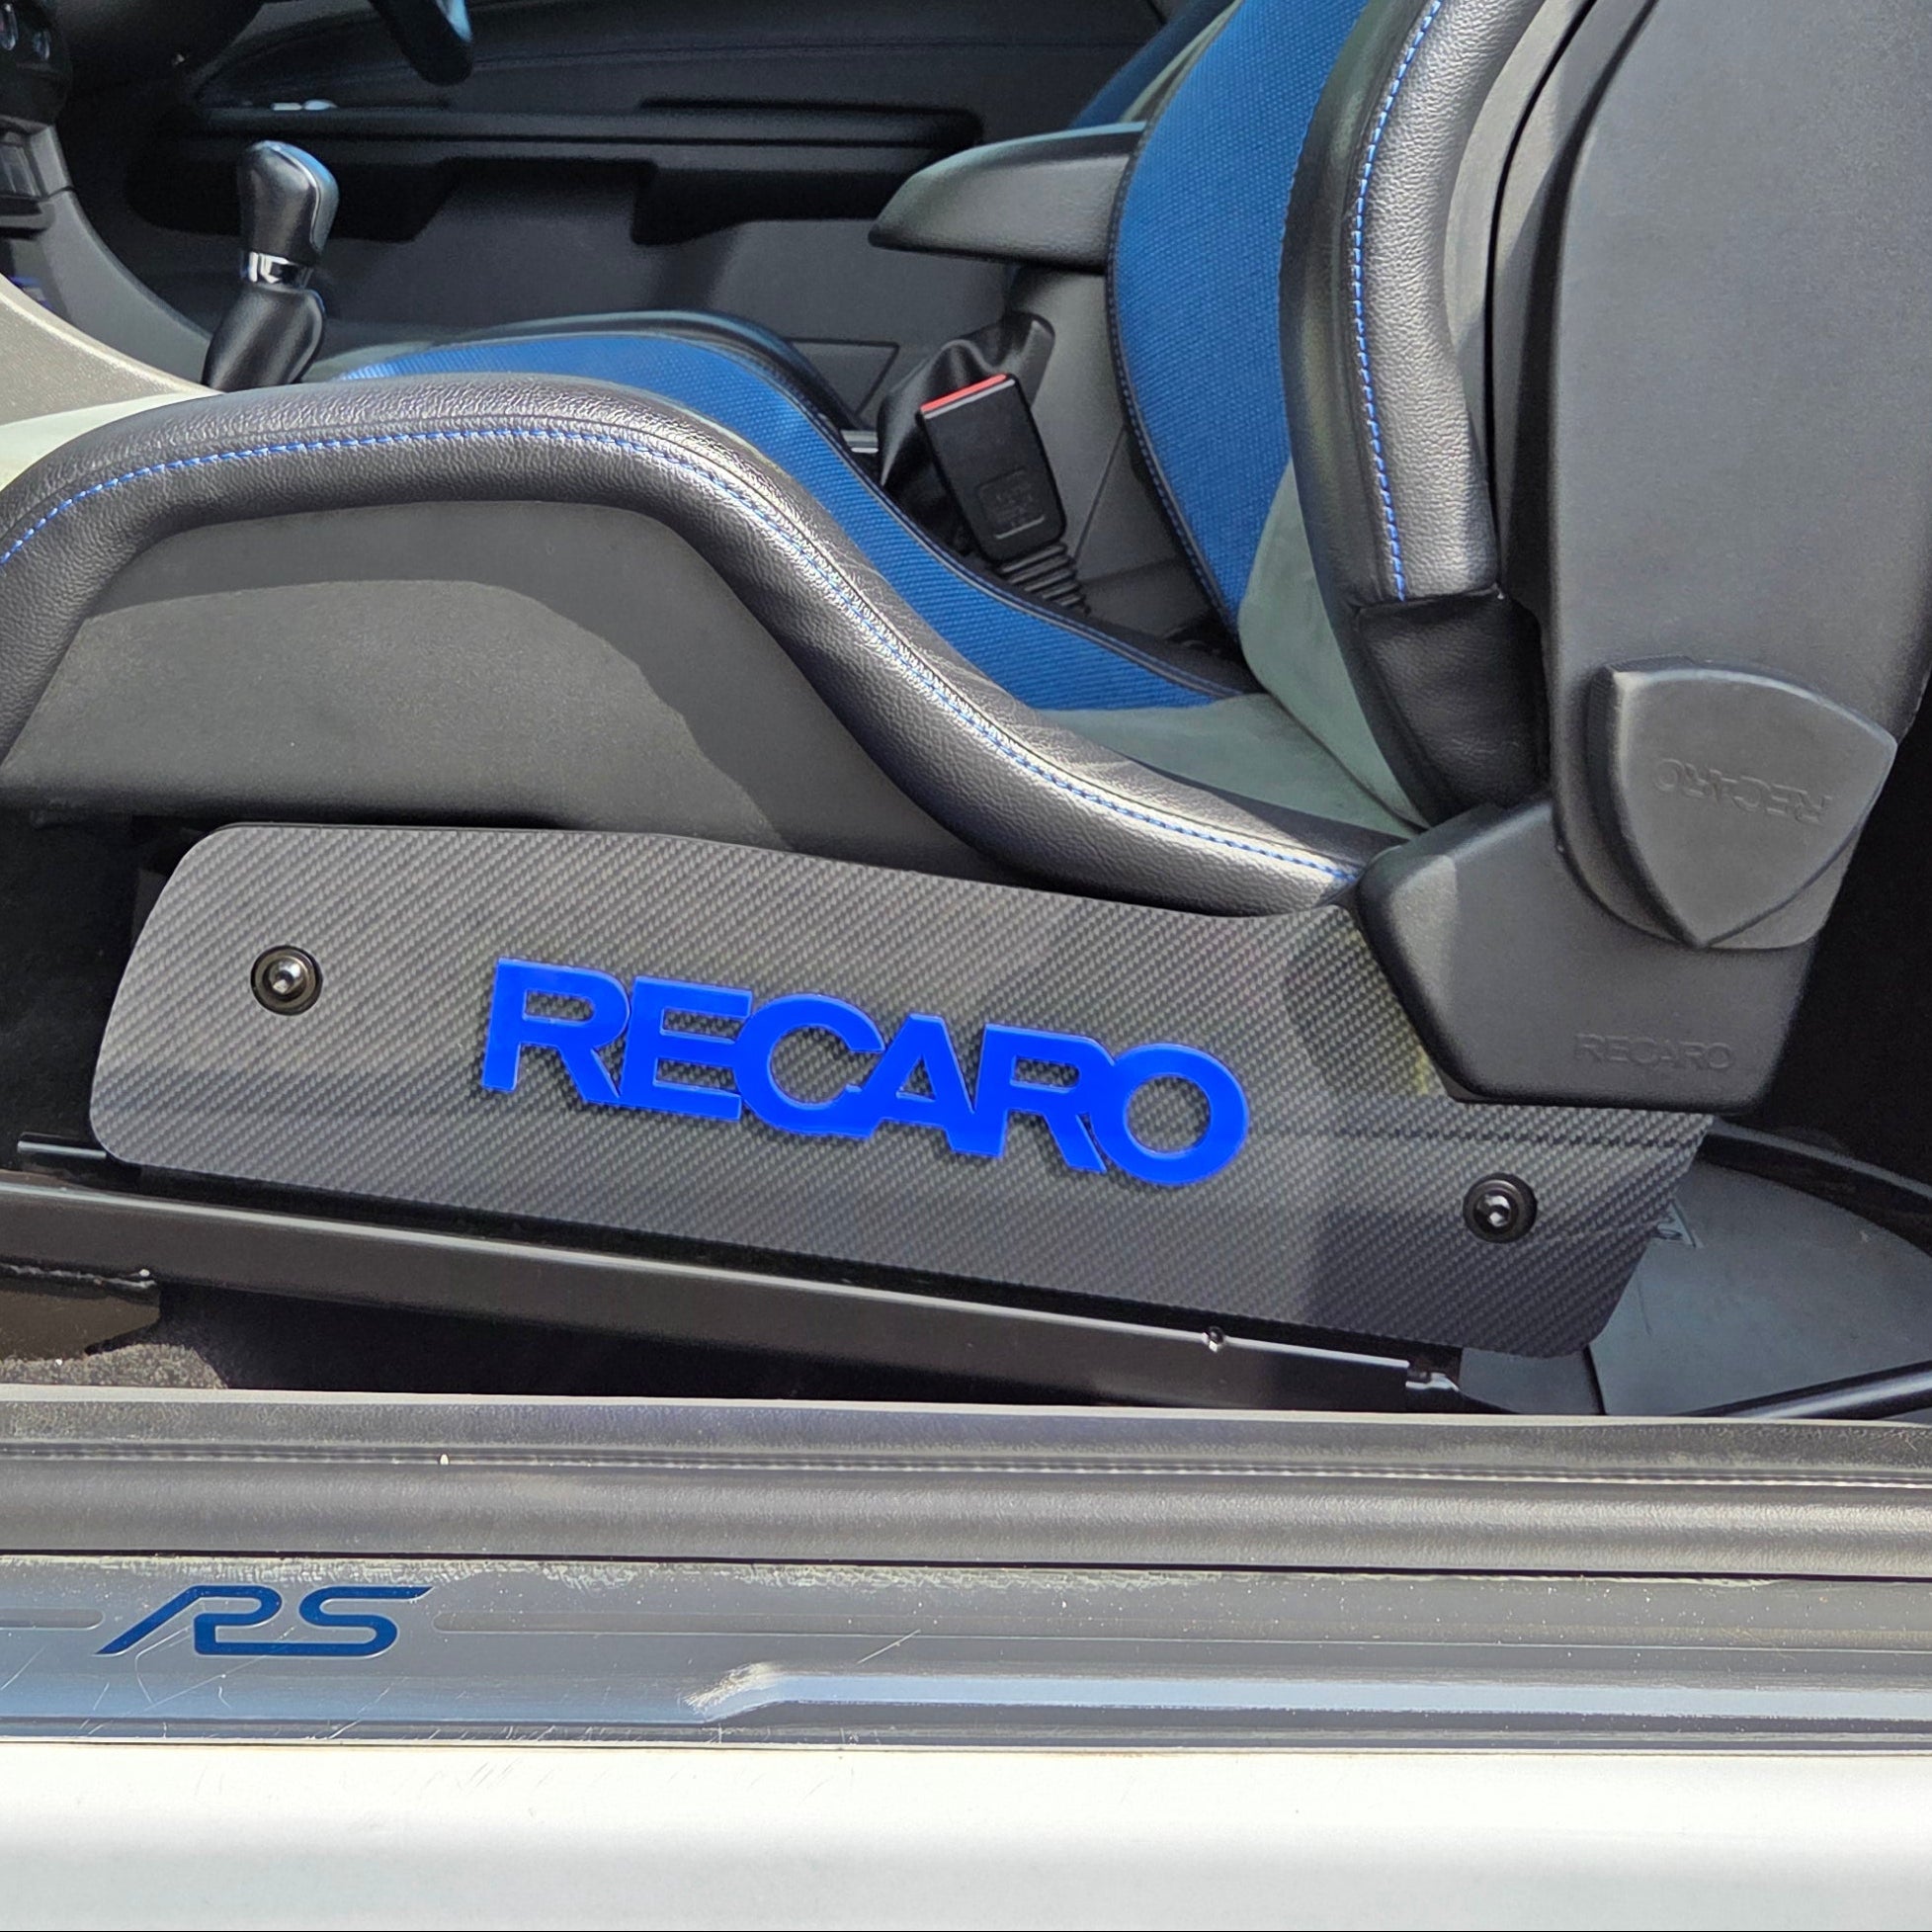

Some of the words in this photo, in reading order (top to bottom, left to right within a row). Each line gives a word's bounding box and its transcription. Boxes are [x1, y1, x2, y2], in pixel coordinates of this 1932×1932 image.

[1655, 758, 1831, 824] RECARO
[482, 958, 1248, 1186] RECARO
[1575, 1033, 1733, 1071] RECARO
[95, 1585, 433, 1658] RS
